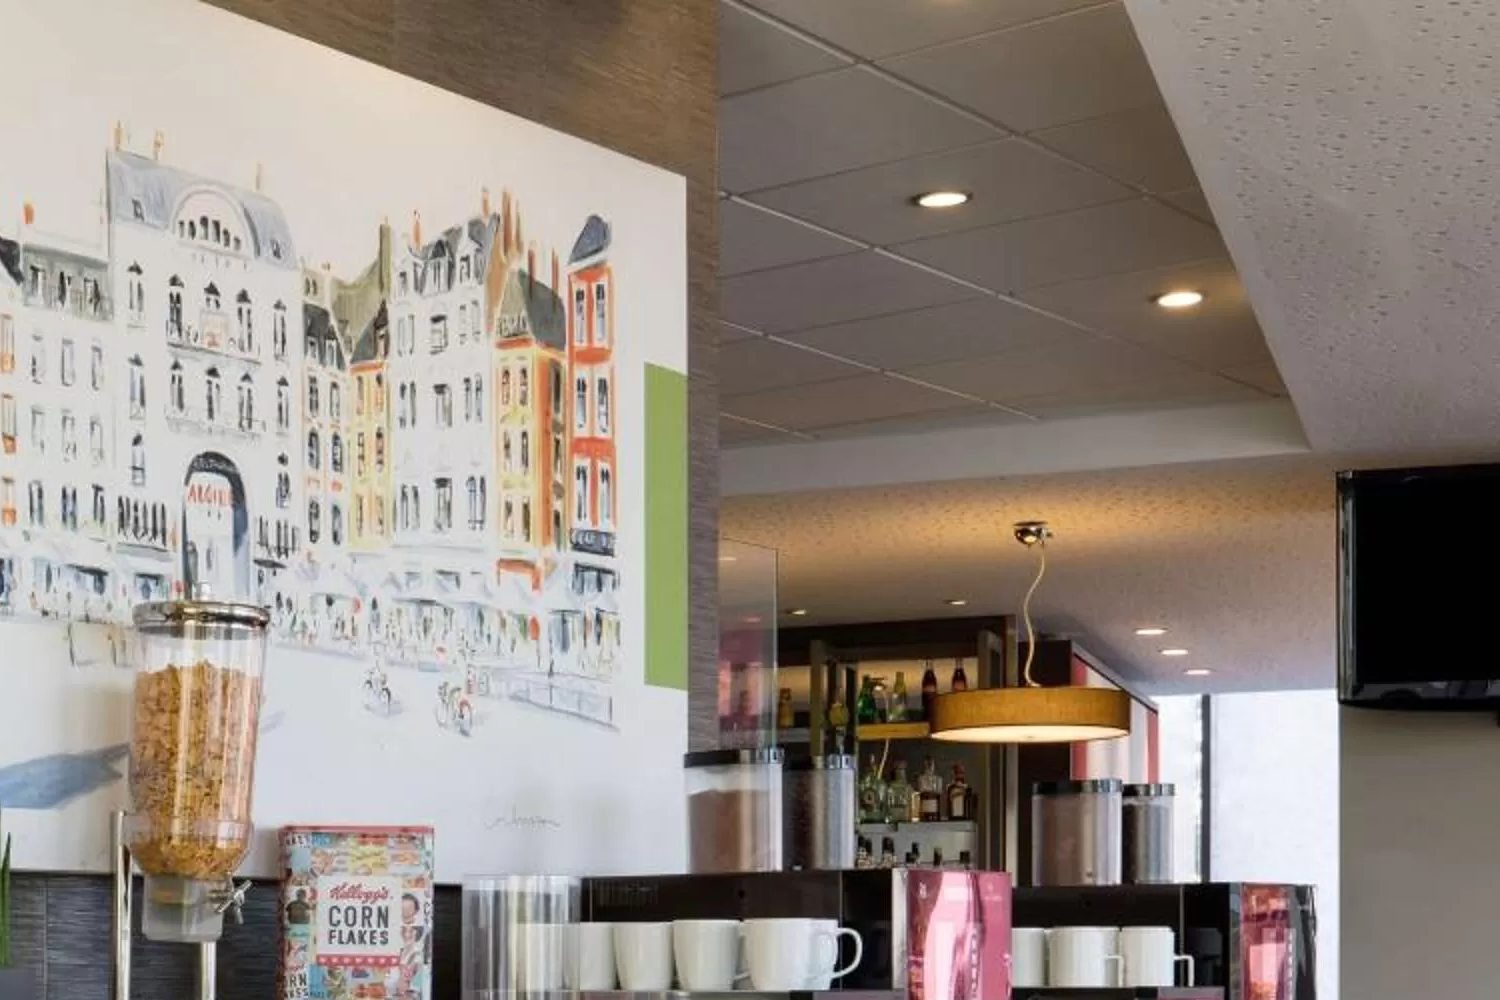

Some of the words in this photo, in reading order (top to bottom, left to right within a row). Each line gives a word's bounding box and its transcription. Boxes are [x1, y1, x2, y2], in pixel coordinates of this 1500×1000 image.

[328, 882, 390, 905] Kellogg's
[328, 905, 389, 929] CORN
[328, 929, 389, 946] FLAKES
